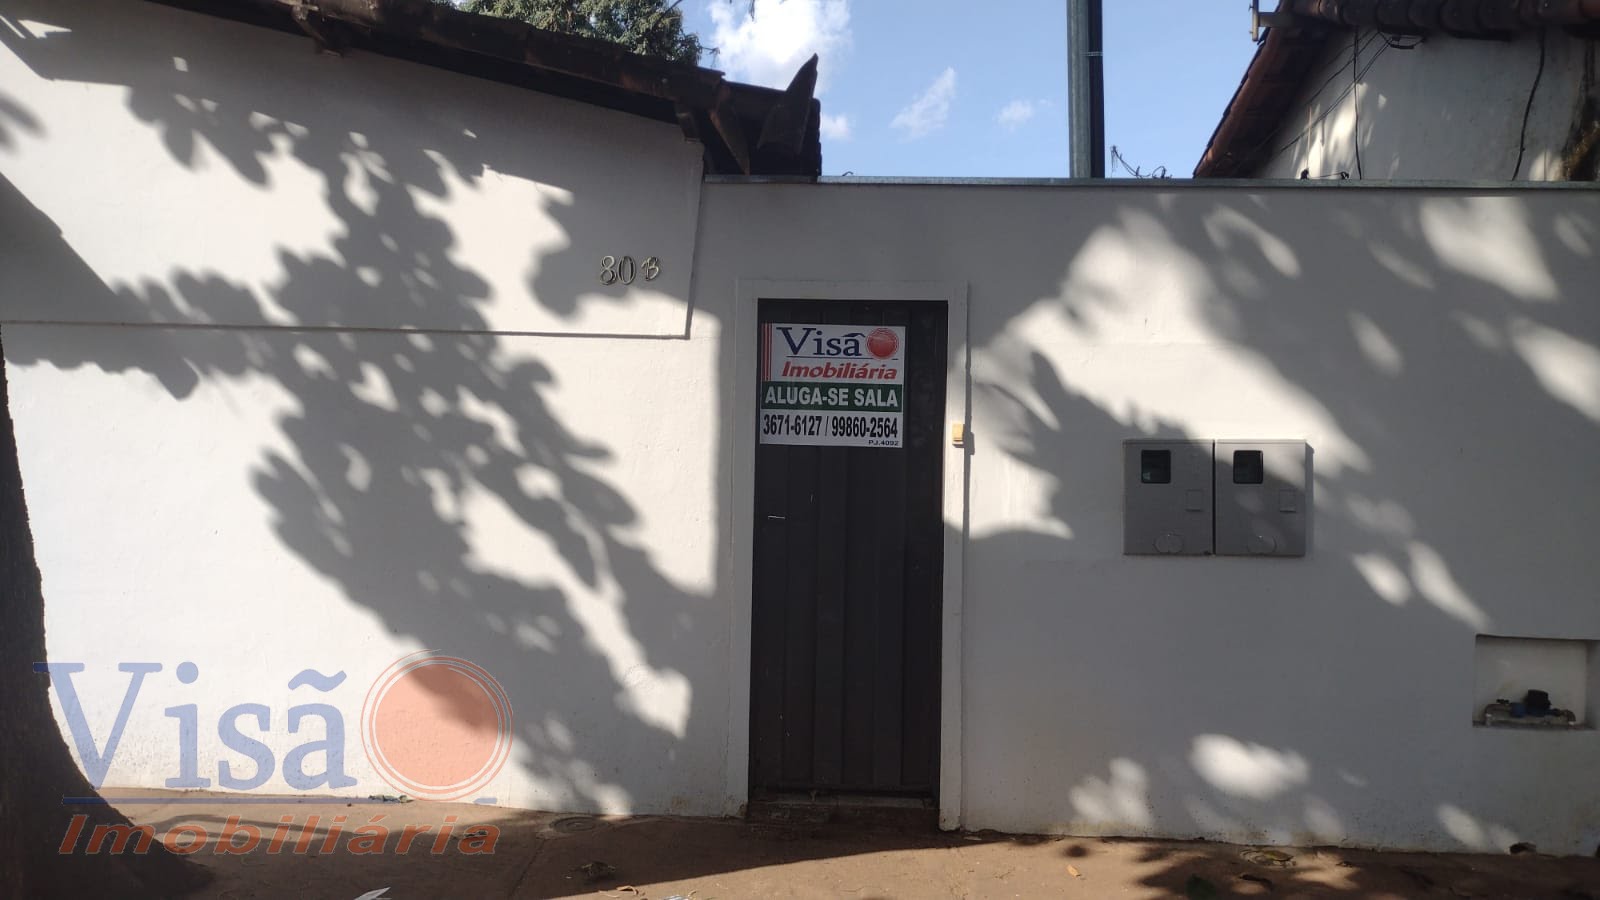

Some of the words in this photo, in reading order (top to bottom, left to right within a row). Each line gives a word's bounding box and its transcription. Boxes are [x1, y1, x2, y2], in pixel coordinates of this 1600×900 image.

[600, 255, 636, 285] 80
[641, 256, 660, 281] B
[781, 361, 898, 380] Imobiliária
[765, 386, 849, 406] ALUGA-SE
[854, 388, 898, 407] SALA
[763, 414, 822, 436] 3671-6127
[831, 416, 898, 438] 99860-2564
